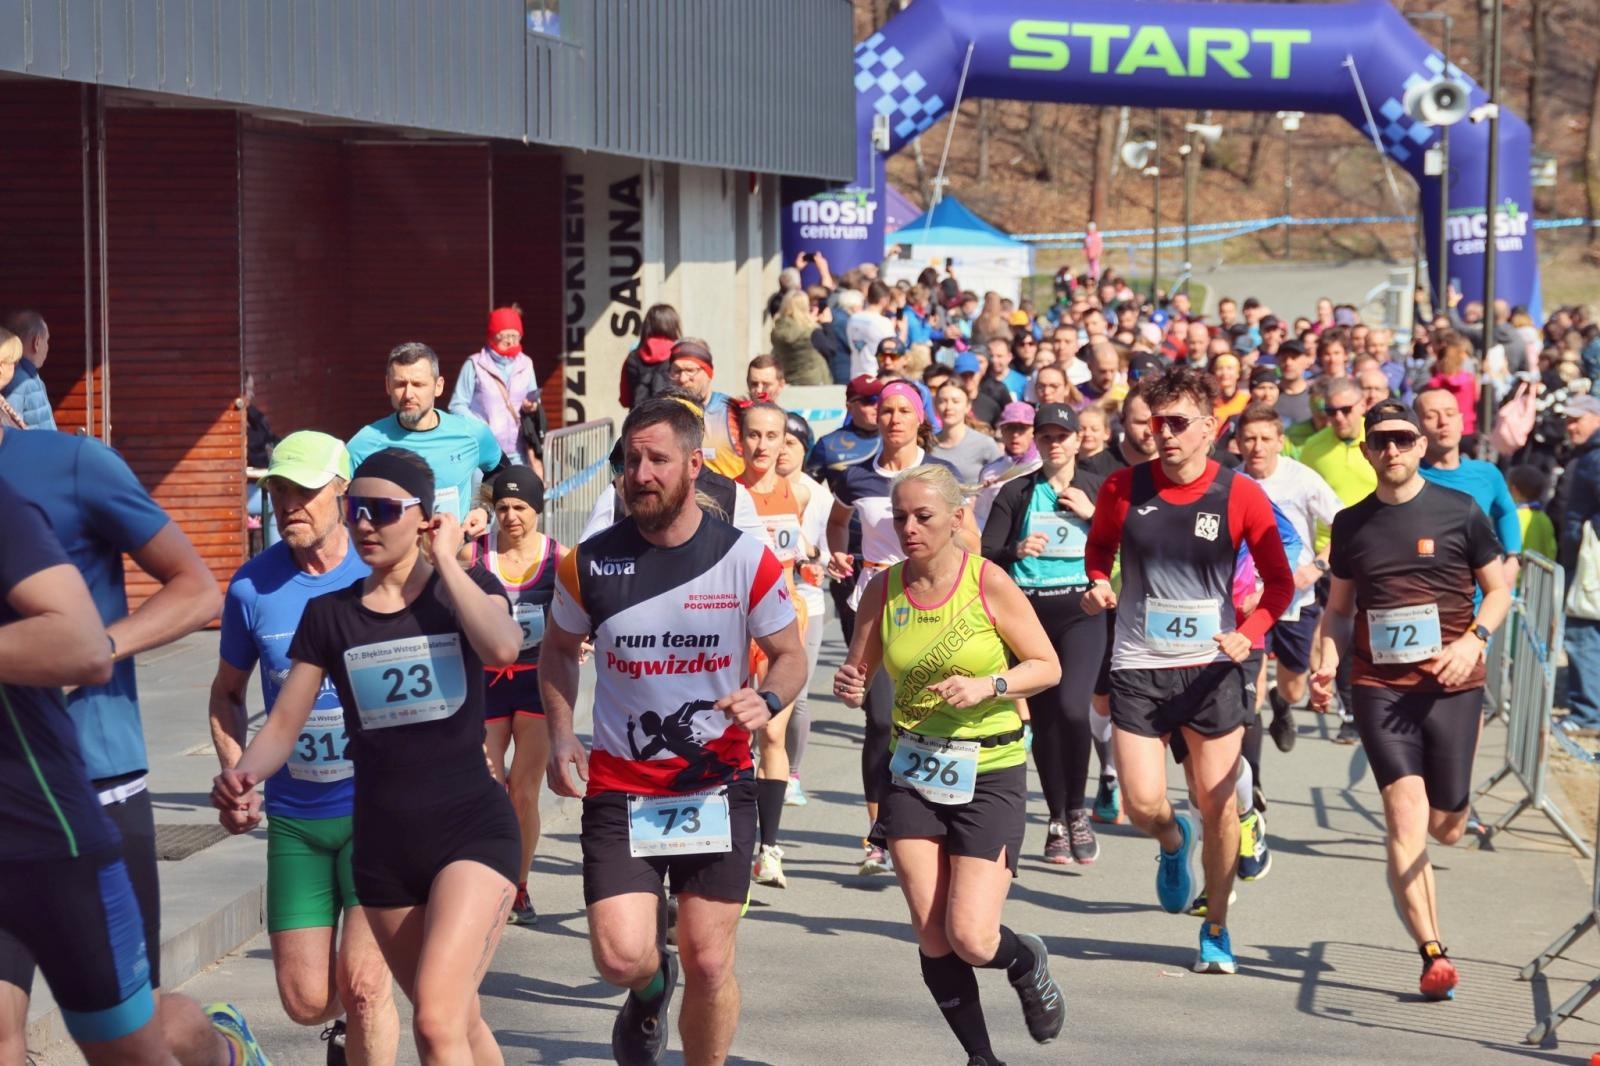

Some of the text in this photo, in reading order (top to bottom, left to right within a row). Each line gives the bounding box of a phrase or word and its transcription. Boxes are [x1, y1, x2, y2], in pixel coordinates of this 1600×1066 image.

[1009, 19, 1311, 79] START
[792, 196, 877, 224] mosir
[800, 223, 868, 240] centrum
[608, 174, 642, 337] SAUNA
[1453, 237, 1523, 255] cenum
[1056, 526, 1069, 544] 9
[590, 560, 635, 576] Nova
[684, 600, 741, 610] POGWIZDÓW
[917, 615, 941, 624] deep
[1166, 616, 1198, 638] 45
[615, 632, 656, 649] run
[662, 631, 720, 648] team
[1385, 624, 1419, 649] 72
[606, 651, 732, 680] Pogwizdów
[382, 663, 433, 704] 23
[903, 752, 959, 787] 296
[658, 806, 702, 836] 73
